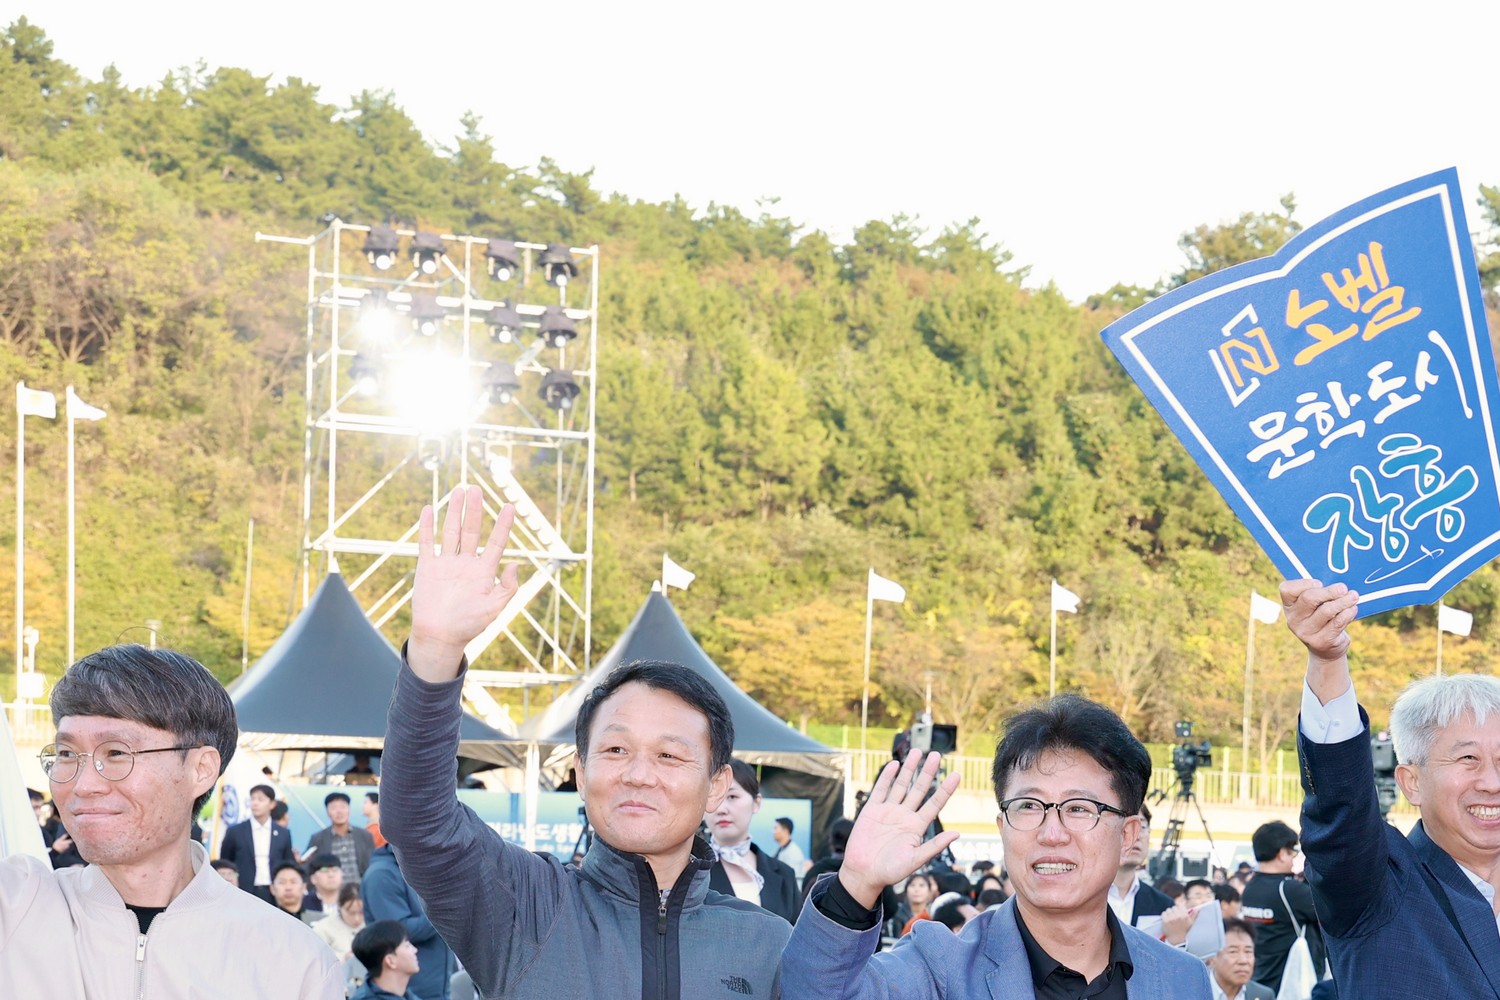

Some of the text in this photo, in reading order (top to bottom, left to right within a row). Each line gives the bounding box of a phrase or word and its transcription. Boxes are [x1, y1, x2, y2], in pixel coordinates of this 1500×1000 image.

[1285, 241, 1421, 365] 노벨
[1246, 330, 1473, 479] 문학도시
[1302, 433, 1479, 573] 장흥
